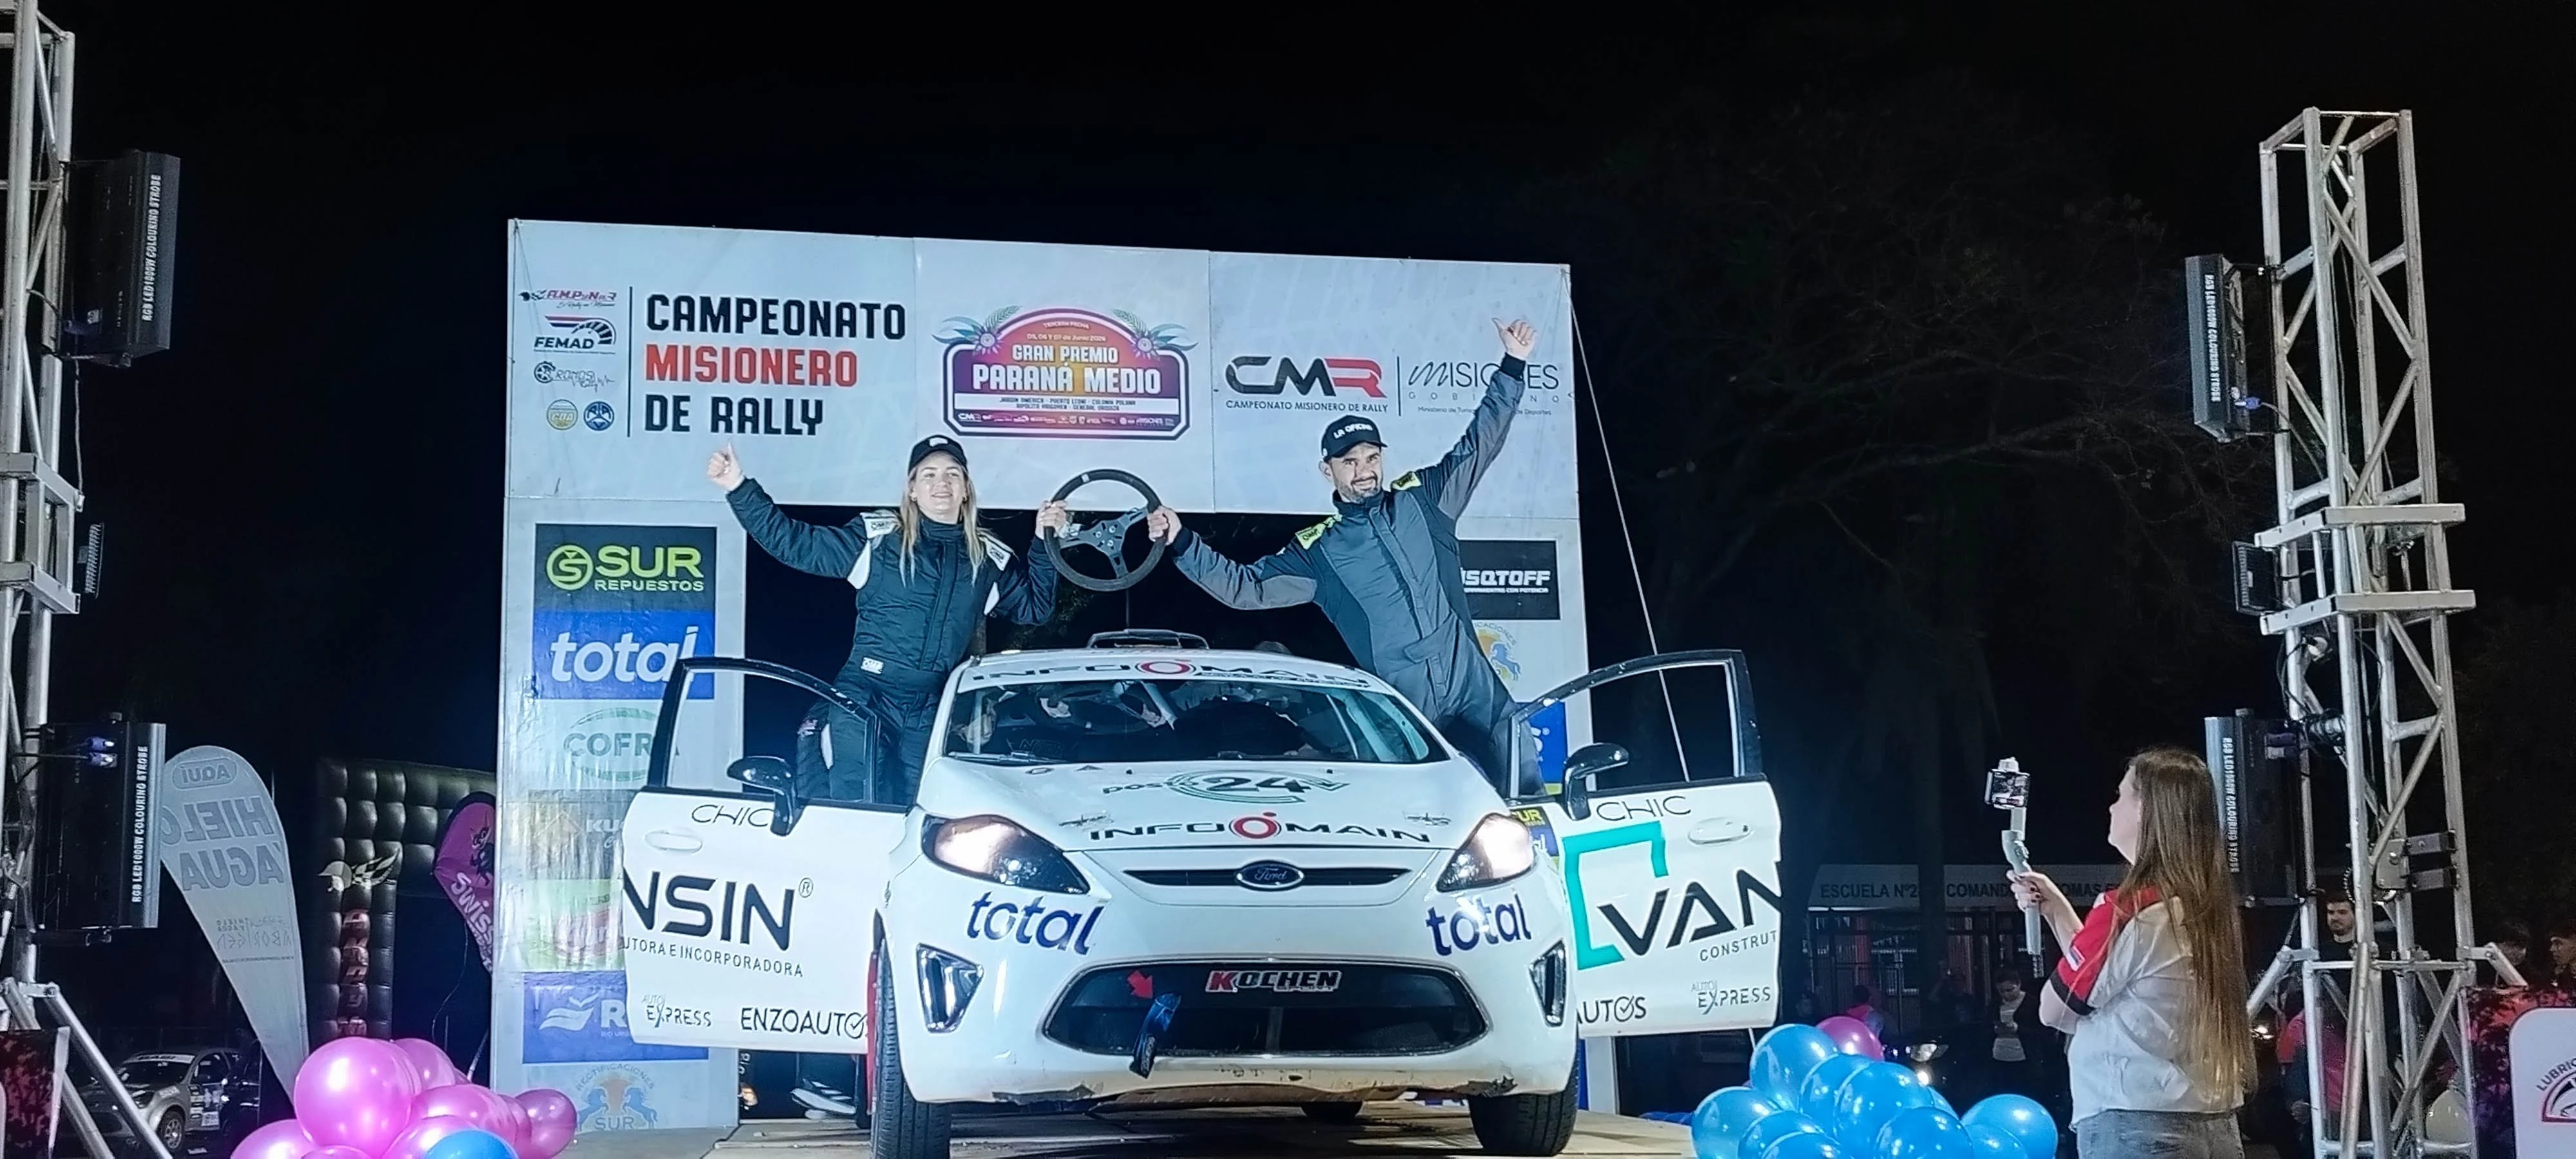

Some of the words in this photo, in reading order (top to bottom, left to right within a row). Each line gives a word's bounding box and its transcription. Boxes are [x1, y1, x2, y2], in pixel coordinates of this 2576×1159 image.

[149, 174, 161, 208] STROBE
[646, 294, 905, 339] CAMPEONATO
[534, 336, 594, 349] FEMAD
[1012, 345, 1054, 362] GRAN
[1059, 346, 1119, 363] PREMIO
[645, 344, 858, 386] MISIONERO
[972, 361, 1074, 392] PARANÁ
[1084, 367, 1161, 394] MEDIO
[1226, 355, 1387, 397] CMR
[645, 394, 690, 432] DE
[710, 396, 824, 436] RALLY
[1226, 400, 1292, 410] CAMPEONATO
[1295, 402, 1345, 411] MISIONERO
[1363, 404, 1388, 412] RALLY
[595, 545, 704, 578] SUR
[594, 580, 705, 591] REPUESTOS
[550, 626, 699, 683] total
[1202, 777, 1311, 793] 24
[692, 804, 773, 827] CHIC
[1596, 796, 1692, 822] CHIC
[131, 883, 142, 902] RGB
[137, 746, 148, 781] STROBE
[1255, 867, 1287, 881] Ford
[1821, 883, 1889, 898] ESCUELA
[966, 891, 1105, 956] total
[1426, 892, 1531, 956] total
[670, 944, 676, 956] E
[680, 945, 803, 977] INCORPORADORA
[1700, 930, 1777, 962] CONSTRUT
[1206, 970, 1342, 992] KOCHEN
[1698, 986, 1771, 1015] EXPRESS
[646, 1004, 712, 1028] EXPRESS
[575, 1063, 654, 1091] RECTIFICACIONES
[594, 1117, 634, 1130] SUR
